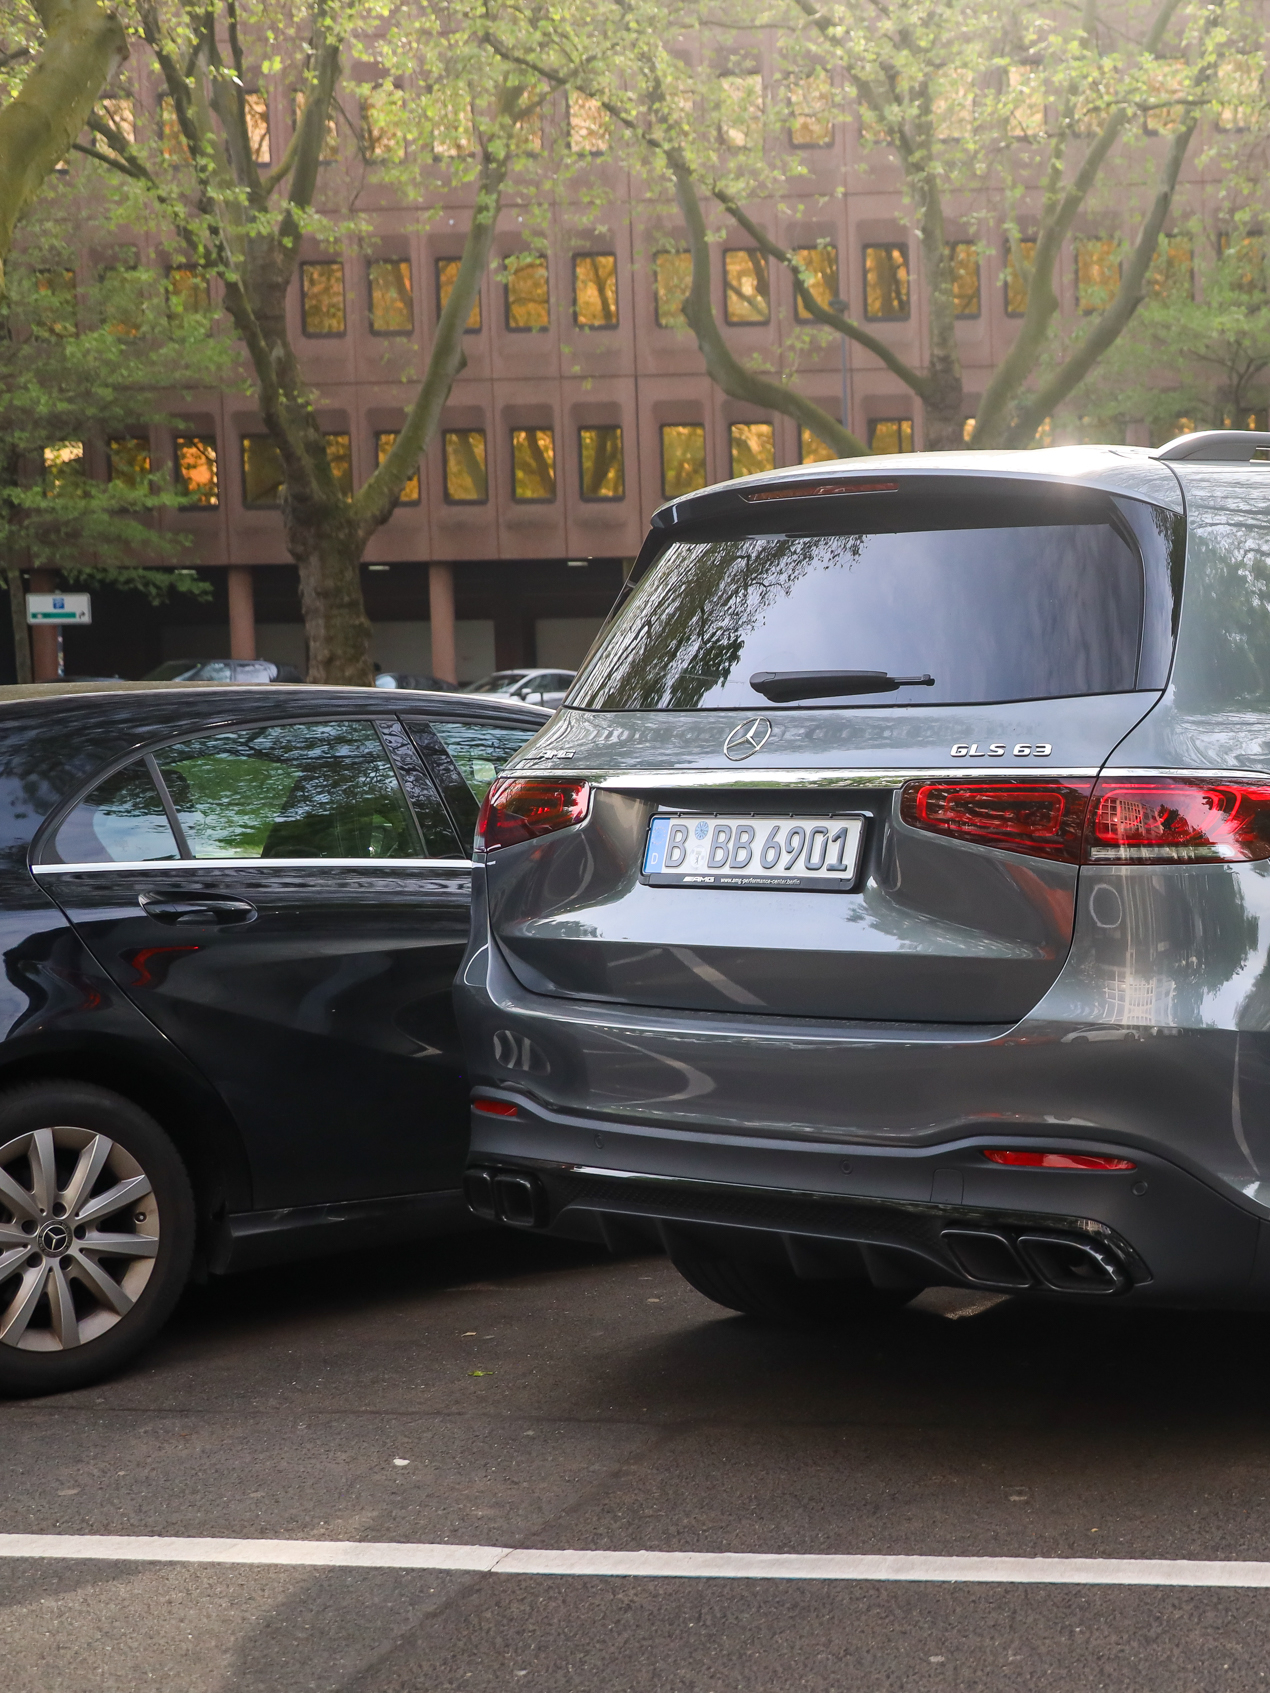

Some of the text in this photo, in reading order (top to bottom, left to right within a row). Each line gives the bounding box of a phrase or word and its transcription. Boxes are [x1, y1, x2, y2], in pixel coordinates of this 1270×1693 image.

[950, 743, 1053, 758] GLS 63
[650, 824, 849, 872] D B BB 6901
